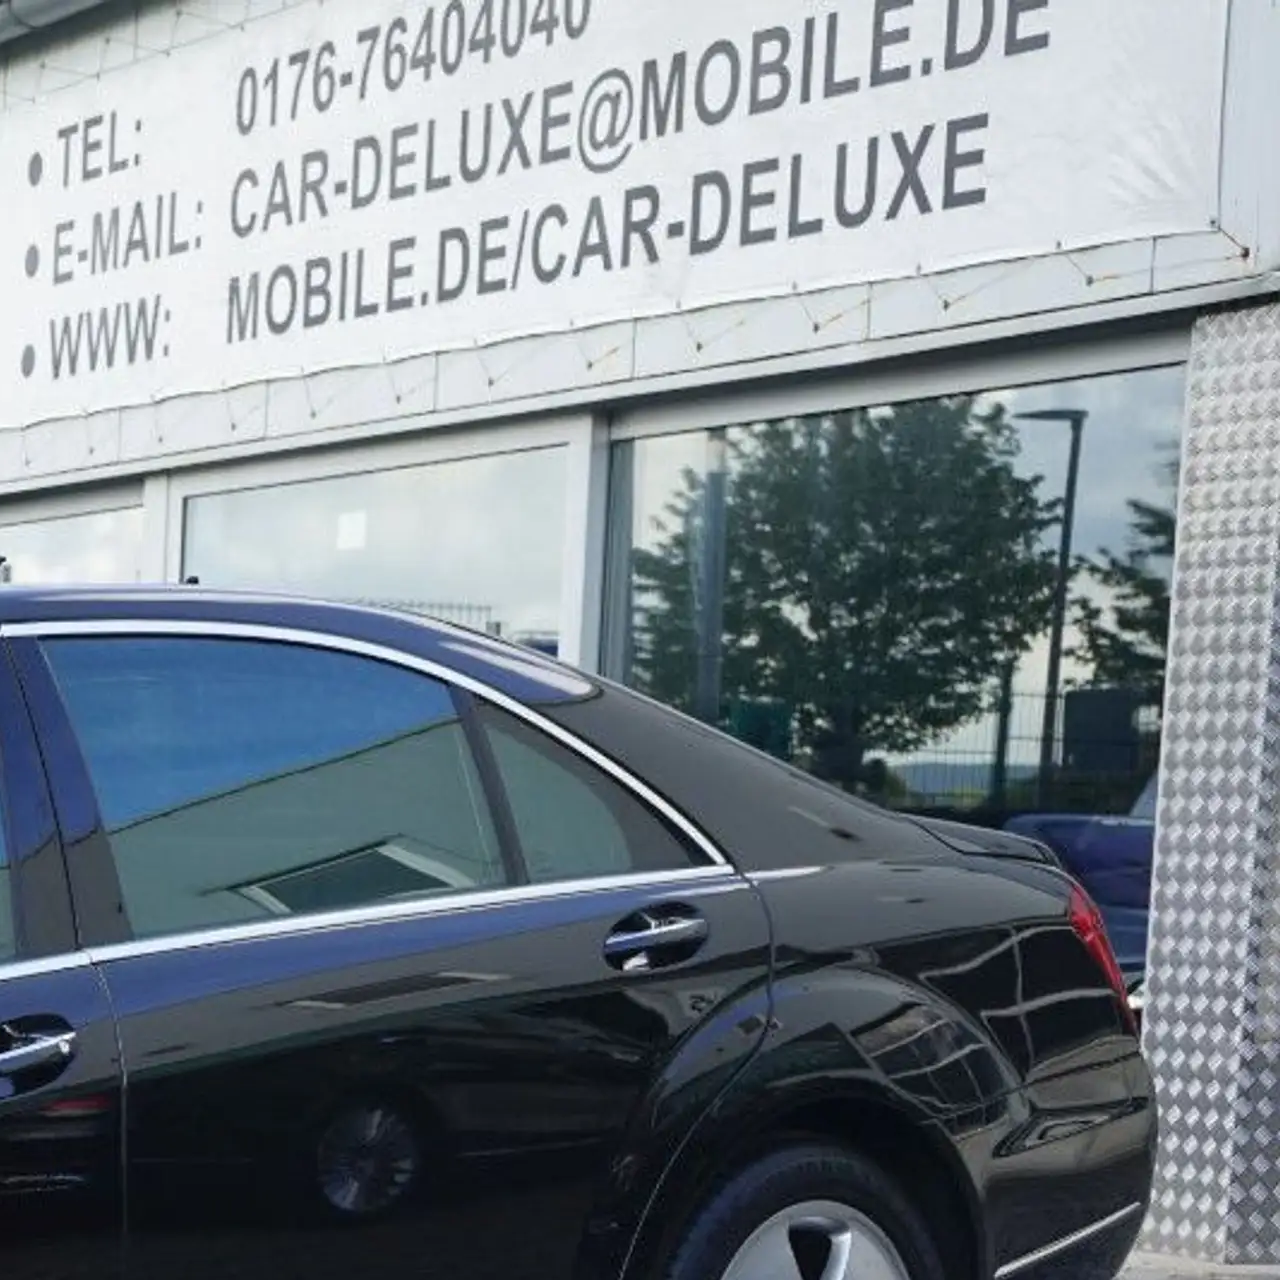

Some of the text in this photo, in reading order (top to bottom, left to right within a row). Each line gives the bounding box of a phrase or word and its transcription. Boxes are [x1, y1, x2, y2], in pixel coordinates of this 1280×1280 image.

[52, 0, 1051, 286] E-MAIL: CAR-DELUXE@MOBILE.DE
[57, 0, 592, 189] TEL: 0176-76404040
[49, 113, 990, 380] WWW: MOBILE.DE/CAR-DELUXE
